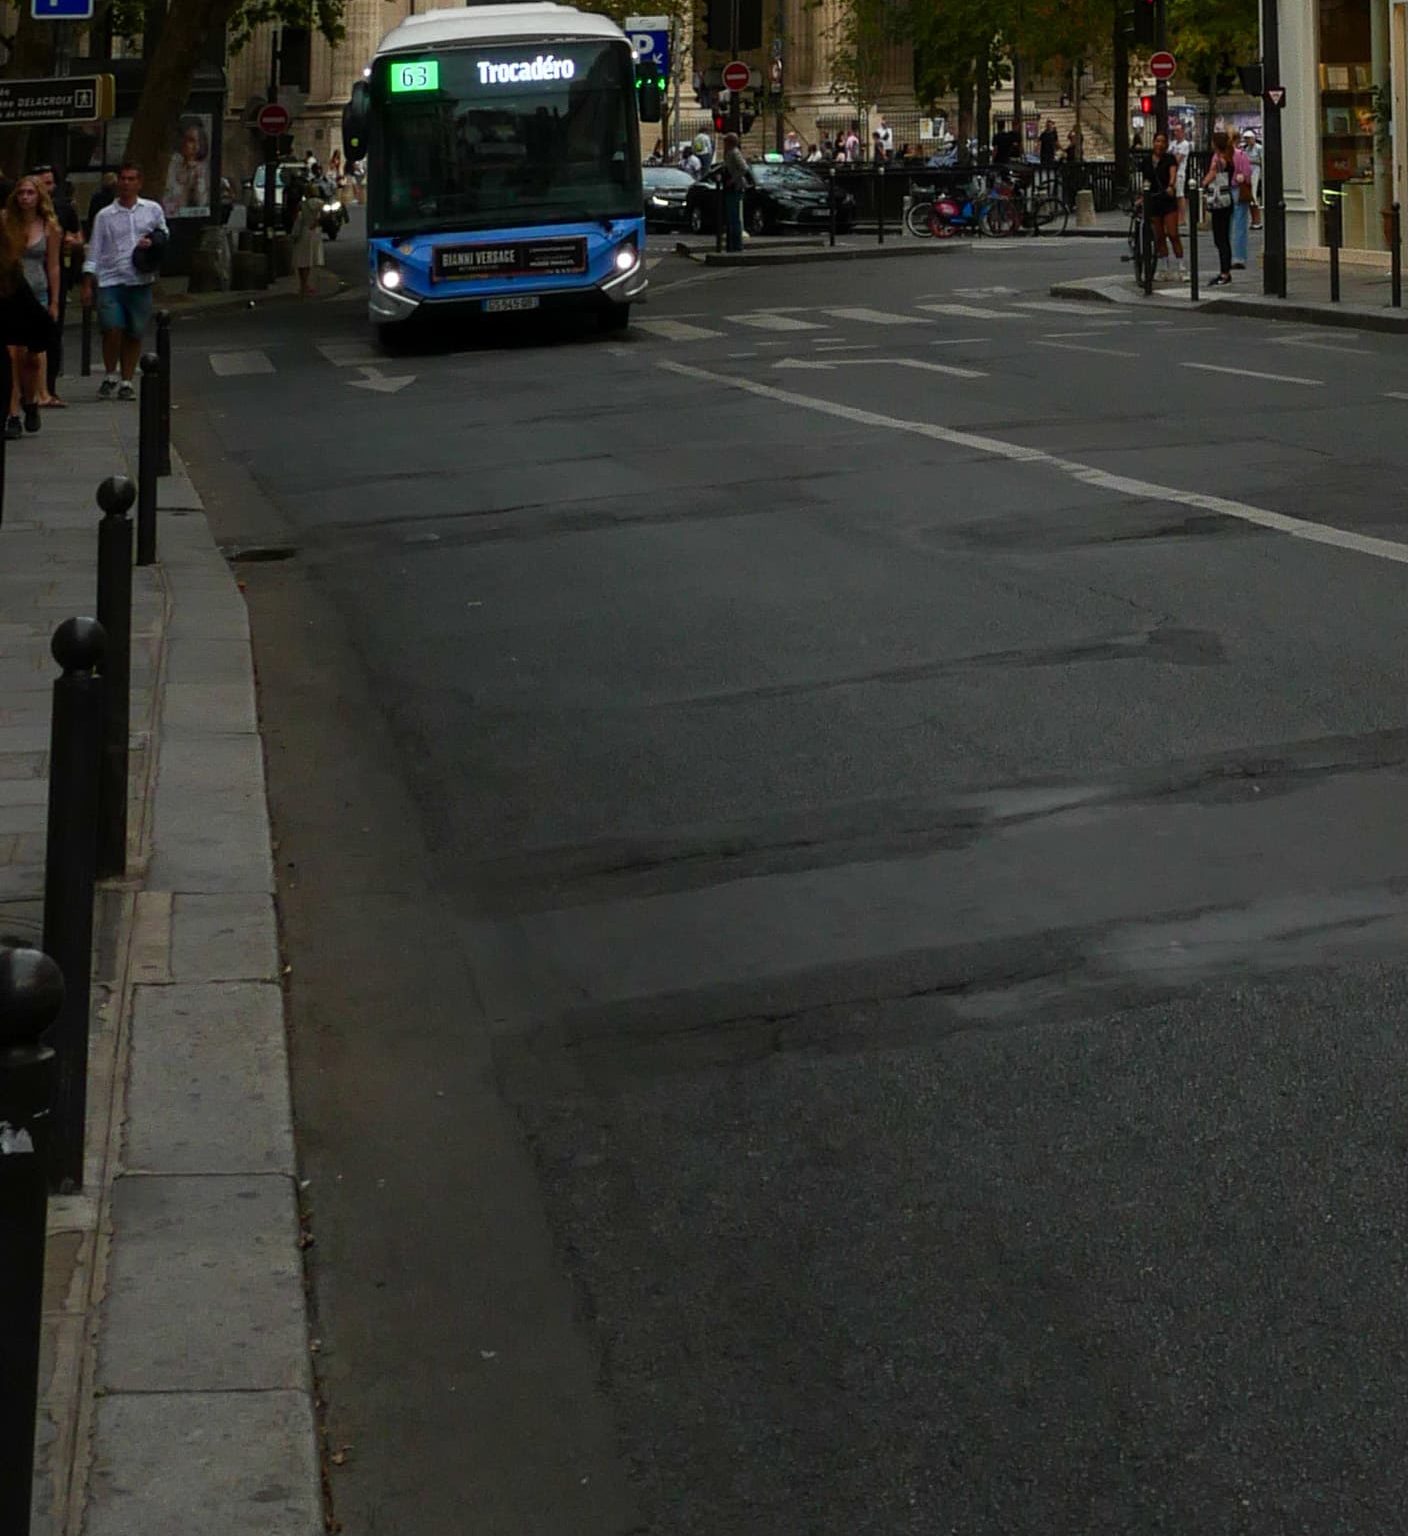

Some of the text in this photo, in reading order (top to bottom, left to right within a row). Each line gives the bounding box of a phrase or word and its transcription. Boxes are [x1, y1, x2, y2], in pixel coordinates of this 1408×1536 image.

[402, 55, 575, 87] 63 Trocadéro
[442, 252, 474, 267] GIANNI
[476, 250, 516, 265] VERSACE
